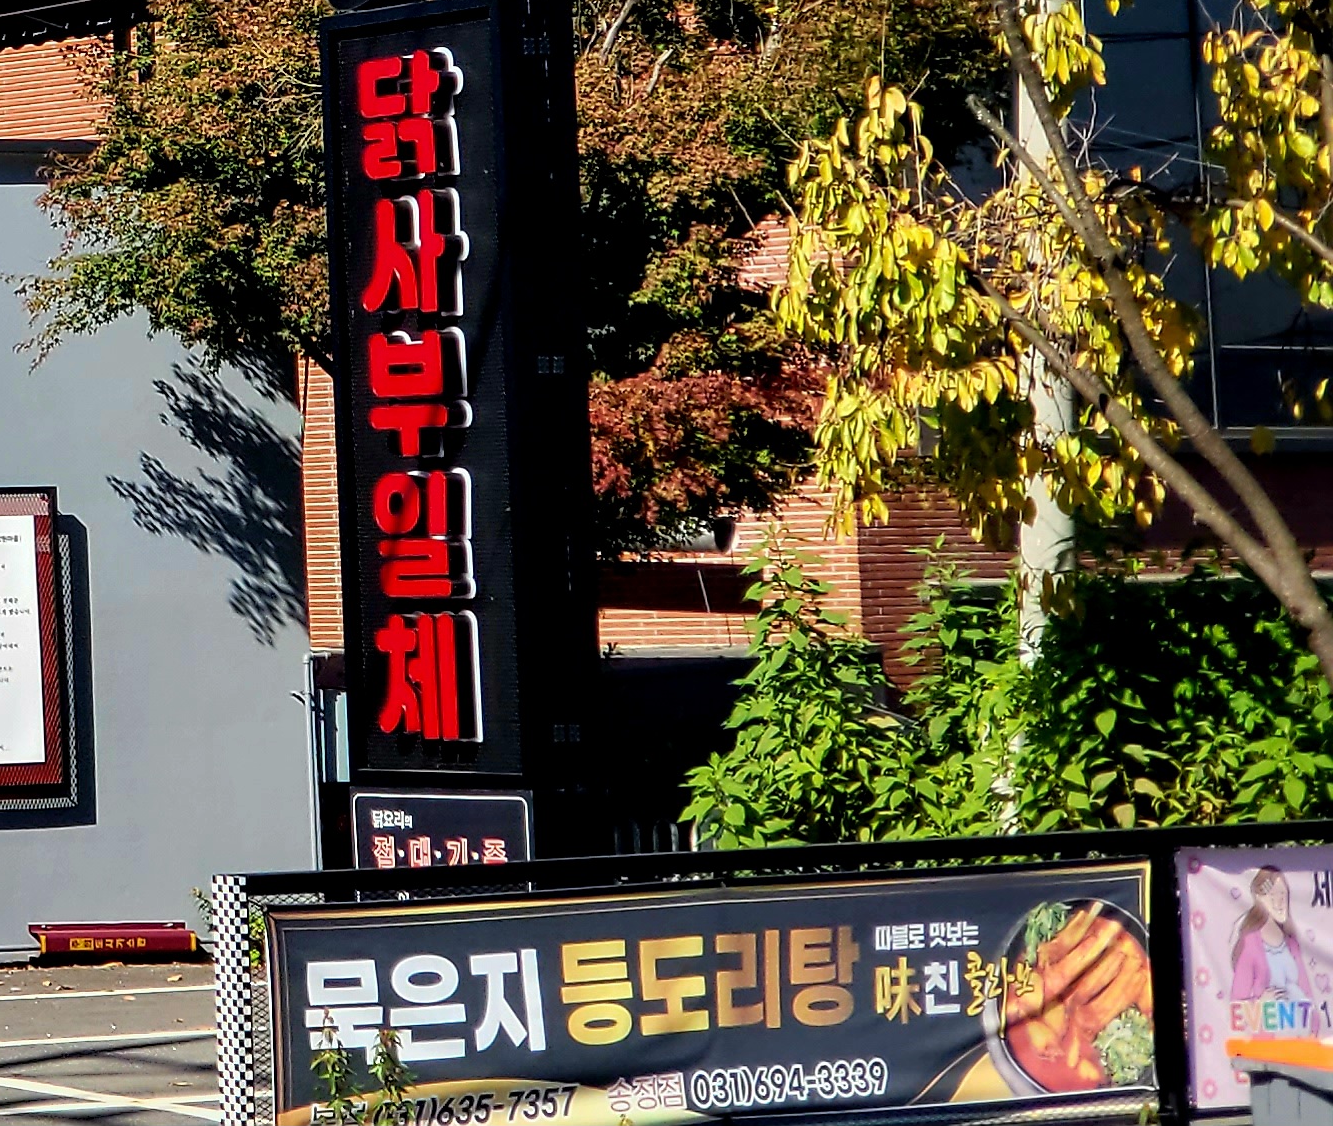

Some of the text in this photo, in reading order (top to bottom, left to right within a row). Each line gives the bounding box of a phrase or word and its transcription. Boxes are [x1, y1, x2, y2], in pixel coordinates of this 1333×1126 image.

[356, 49, 468, 742] 닭사부일체
[371, 809, 413, 829] 닭요리의
[875, 921, 979, 951] 따블로 맛보는
[305, 925, 860, 1065] 묵은지 등도리탕
[874, 951, 1035, 1037] 味친 콜라보
[1230, 1001, 1331, 1031] EVENT 1
[607, 1058, 889, 1113] 송정점 031)694-3339
